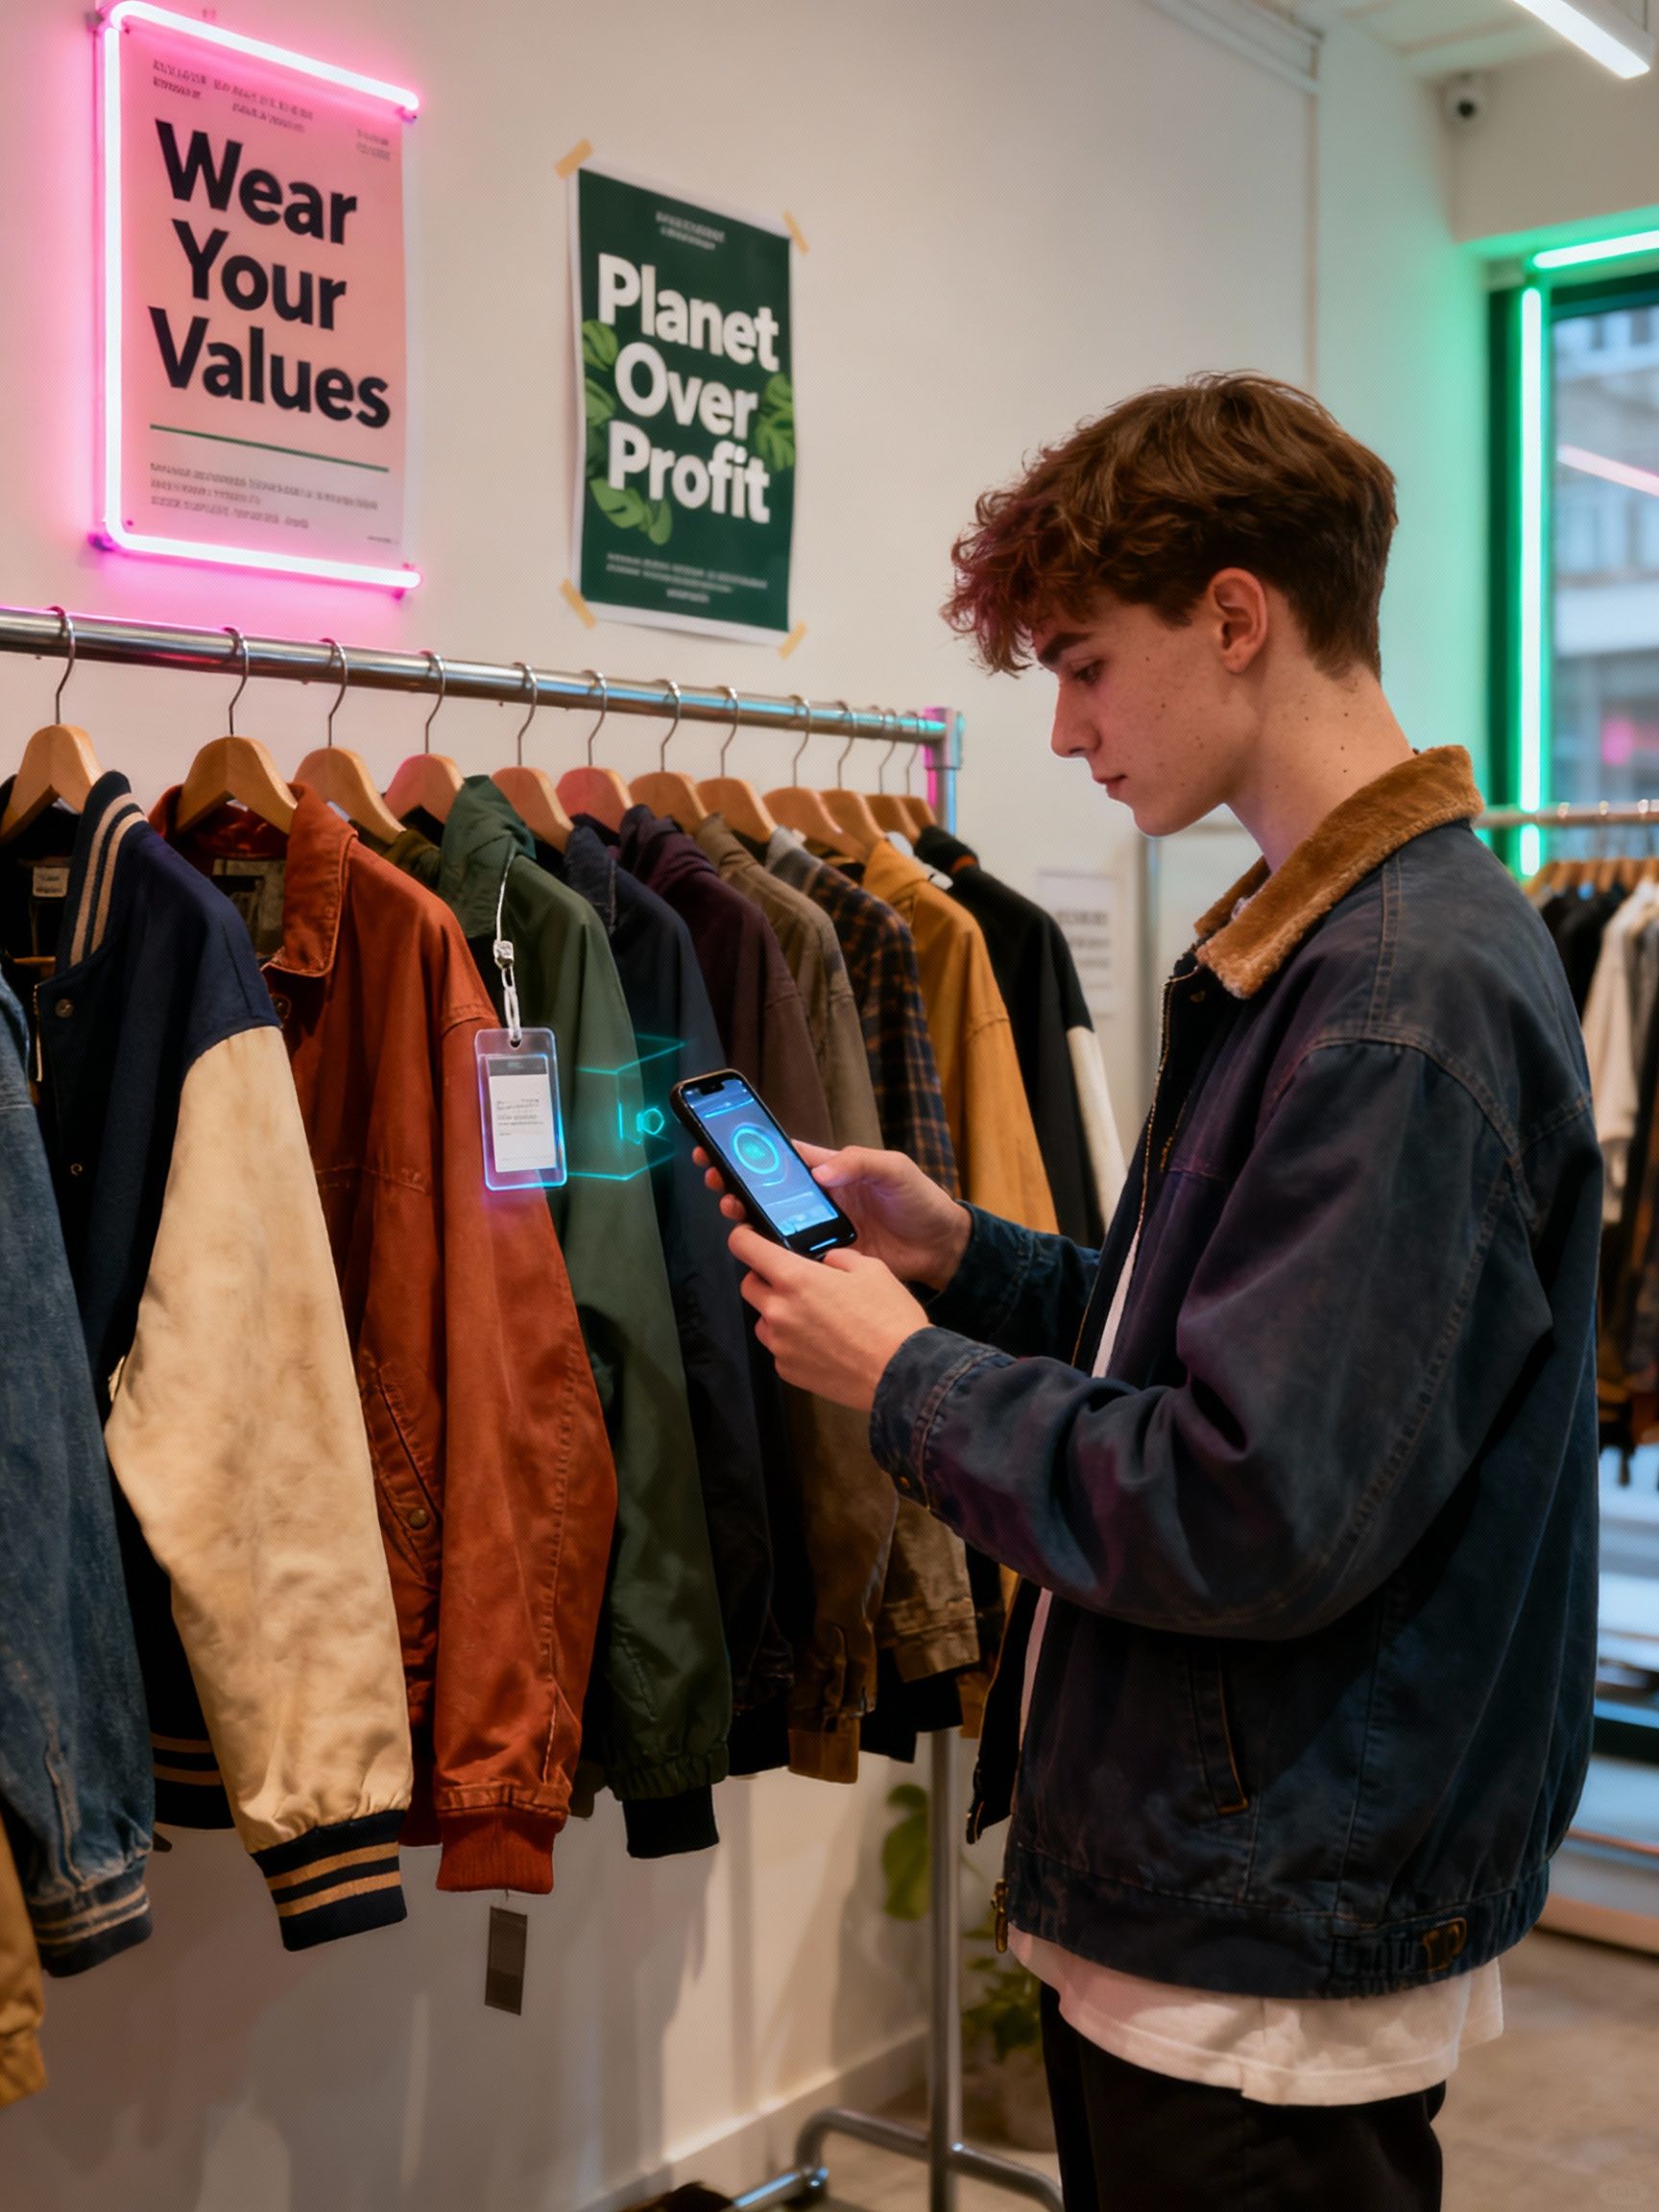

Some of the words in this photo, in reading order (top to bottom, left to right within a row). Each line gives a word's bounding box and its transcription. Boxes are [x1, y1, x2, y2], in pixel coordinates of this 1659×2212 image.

[155, 118, 358, 246] Wear
[171, 218, 349, 332] Your
[597, 252, 780, 373] Planet
[148, 305, 391, 429] Values
[615, 341, 758, 440] Over
[608, 420, 771, 524] Profit
